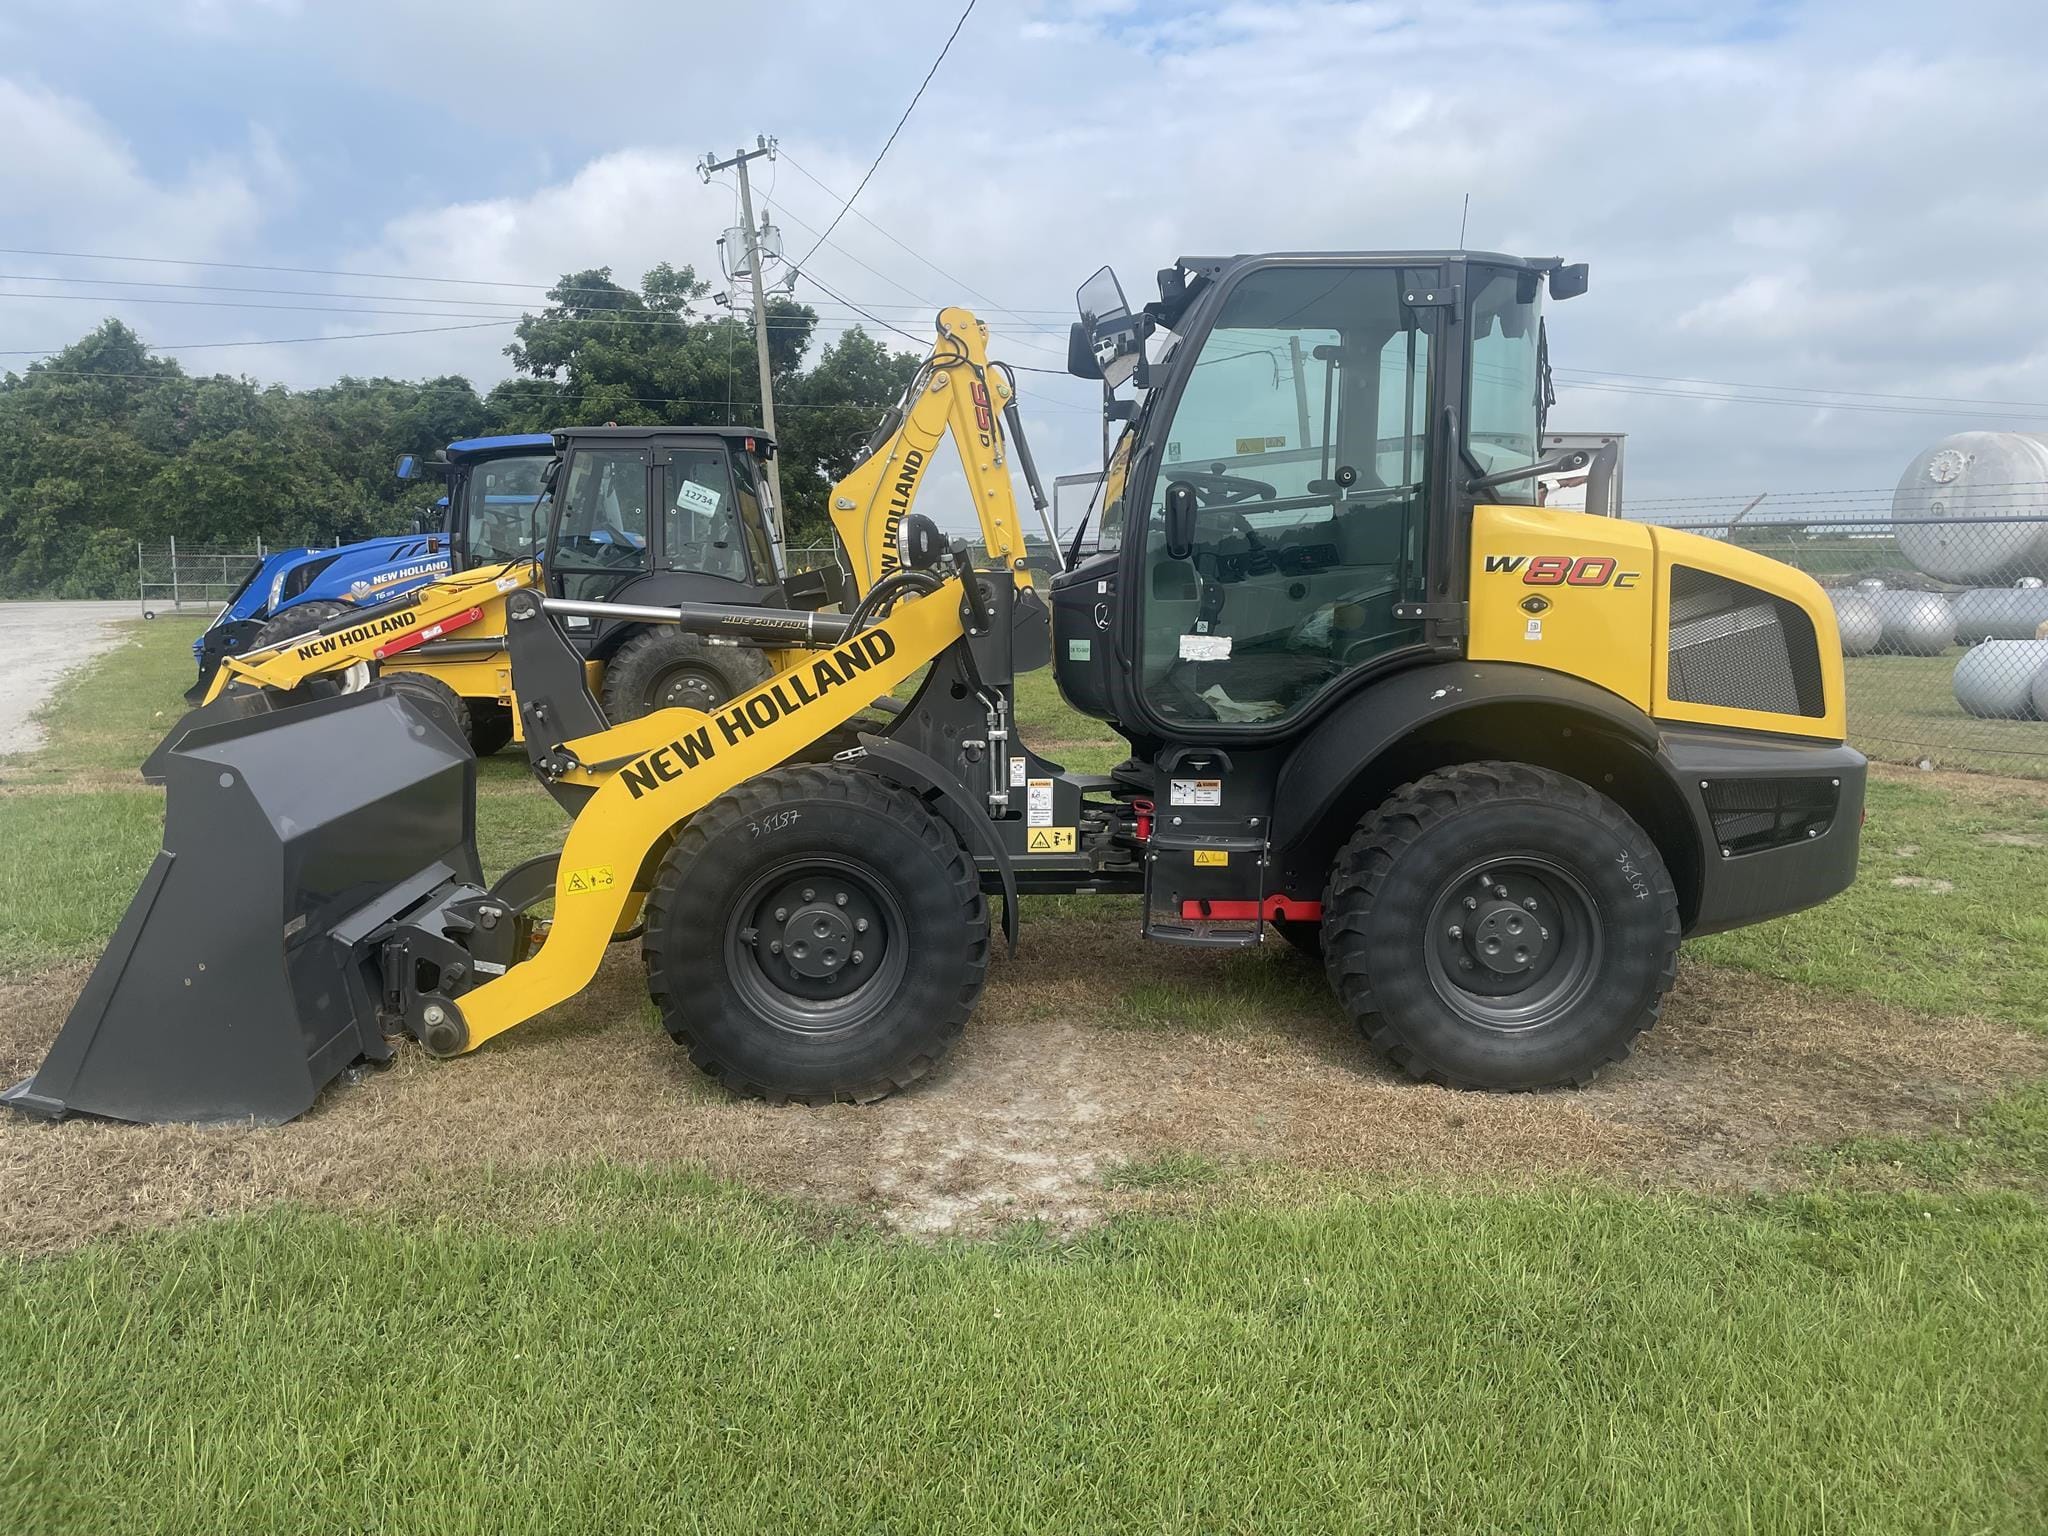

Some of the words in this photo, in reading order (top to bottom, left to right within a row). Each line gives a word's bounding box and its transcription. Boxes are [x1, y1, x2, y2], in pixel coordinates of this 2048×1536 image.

[684, 490, 713, 506] 12734
[883, 450, 923, 549] HOLLAND
[373, 571, 397, 585] NEW
[399, 560, 448, 578] HOLLAND
[297, 637, 336, 661] NEW
[339, 611, 416, 647] HOLLAND
[721, 615, 751, 625] RIDE
[752, 618, 807, 630] CONTROL
[619, 726, 716, 800] NEW
[715, 628, 896, 747] HOLLAND
[746, 809, 802, 840] 38187
